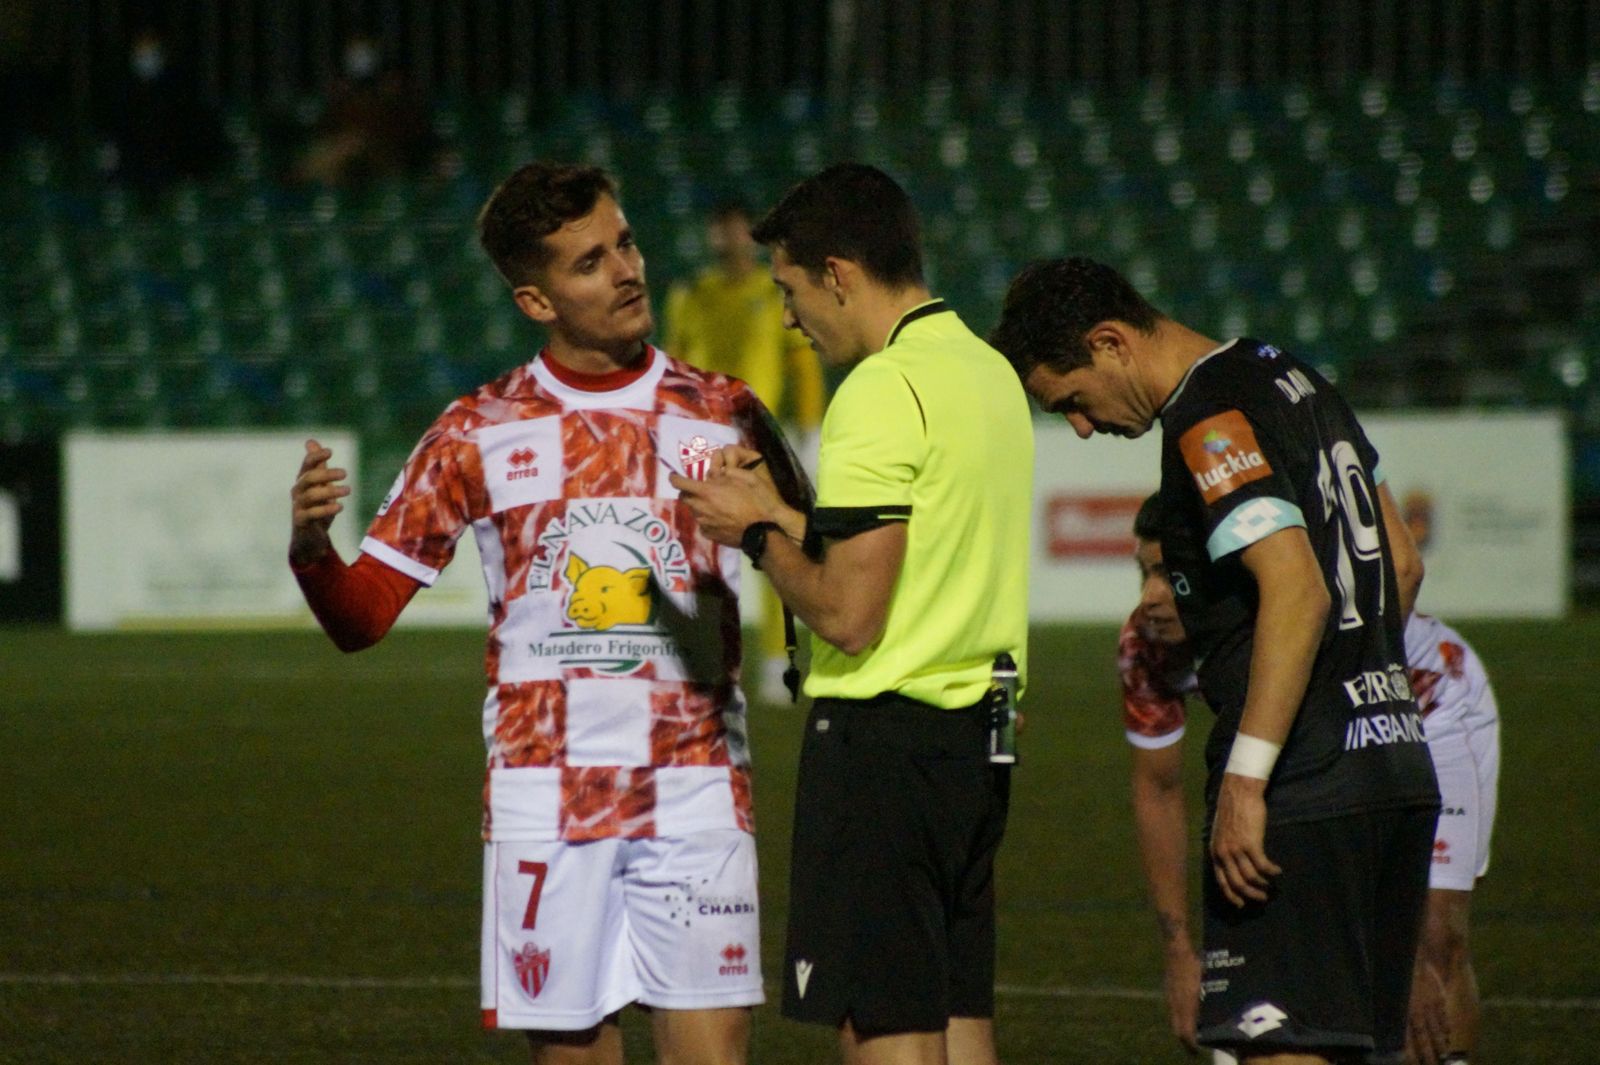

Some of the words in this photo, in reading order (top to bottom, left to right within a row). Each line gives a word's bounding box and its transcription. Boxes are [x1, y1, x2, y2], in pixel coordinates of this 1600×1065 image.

[506, 467, 539, 481] errea
[1196, 449, 1265, 491] luckia
[528, 641, 603, 658] Matadero
[518, 860, 549, 930] 7
